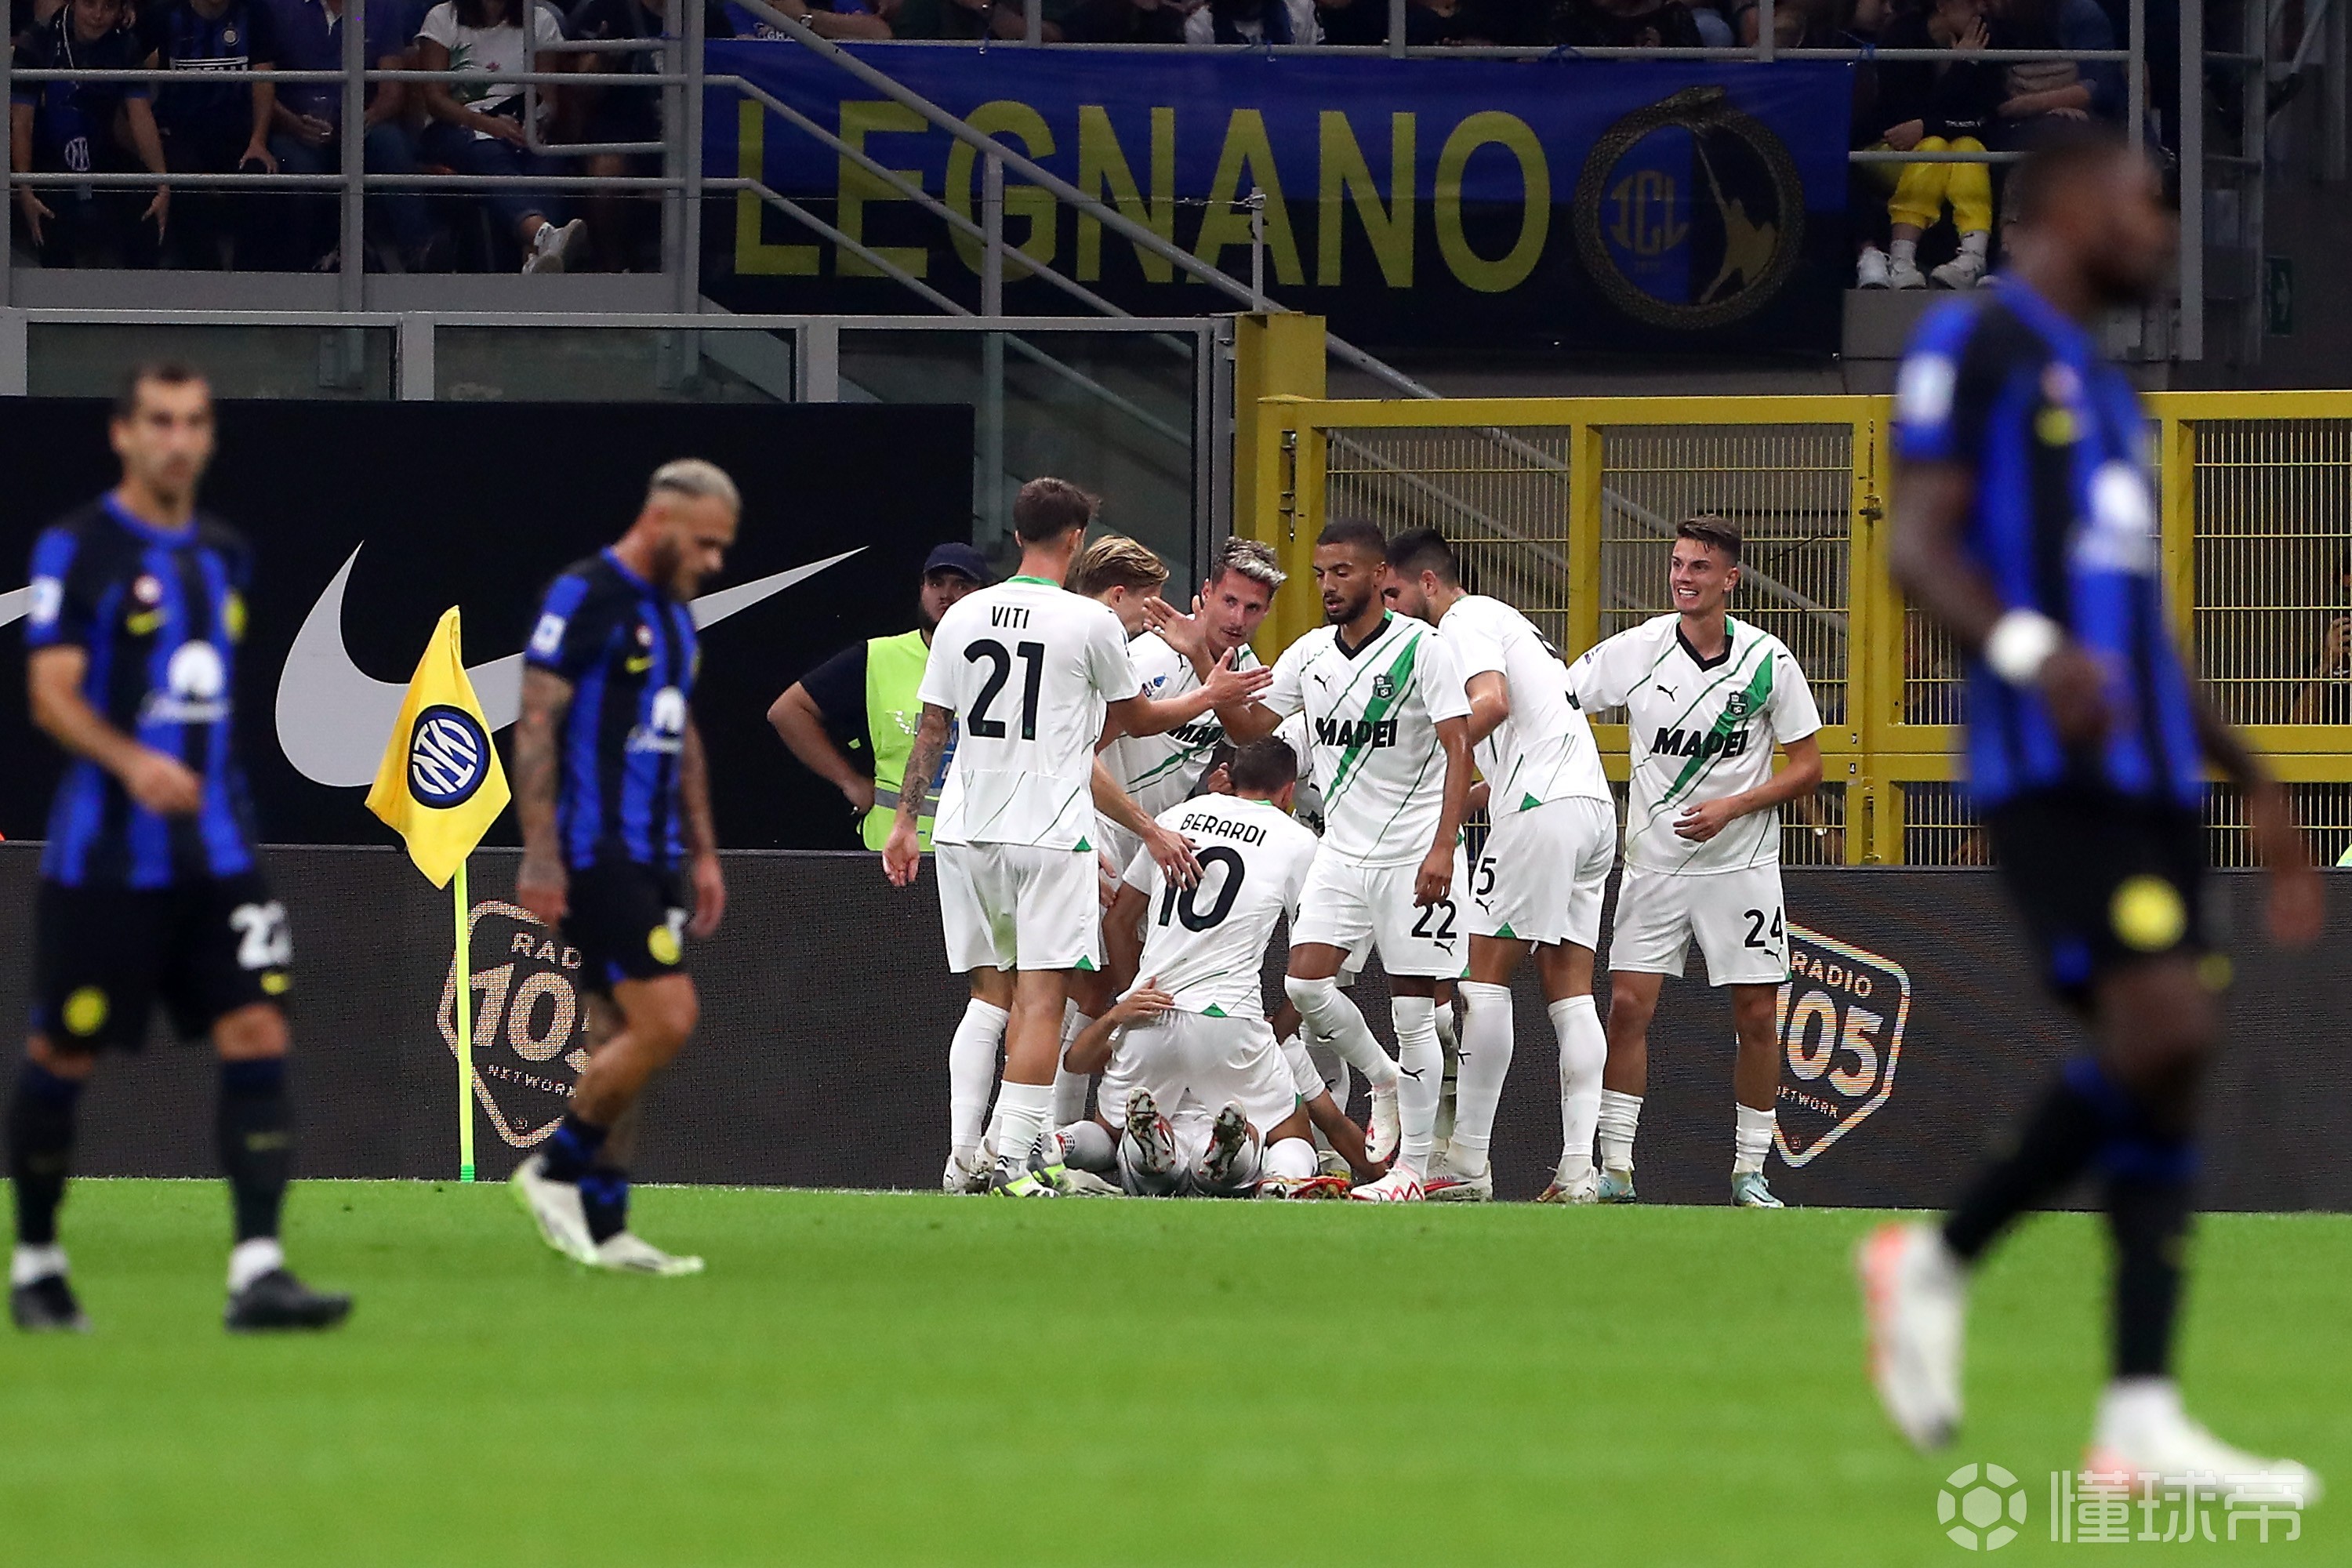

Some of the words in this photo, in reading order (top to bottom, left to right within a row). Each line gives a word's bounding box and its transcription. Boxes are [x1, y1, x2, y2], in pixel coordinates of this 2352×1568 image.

[735, 100, 1550, 292] LEGNANO
[992, 606, 1029, 629] VITI
[964, 639, 1044, 740] 21
[1167, 723, 1224, 746] MAP
[1316, 717, 1398, 748] MAPEI
[1651, 728, 1749, 758] MAPEI
[1180, 813, 1267, 847] BERARDI
[1476, 858, 1497, 895] 5
[1411, 900, 1457, 938] 22
[1744, 906, 1784, 947] 24
[512, 931, 583, 970] RAD
[1791, 951, 1873, 998] RADIO
[470, 963, 590, 1074] 10
